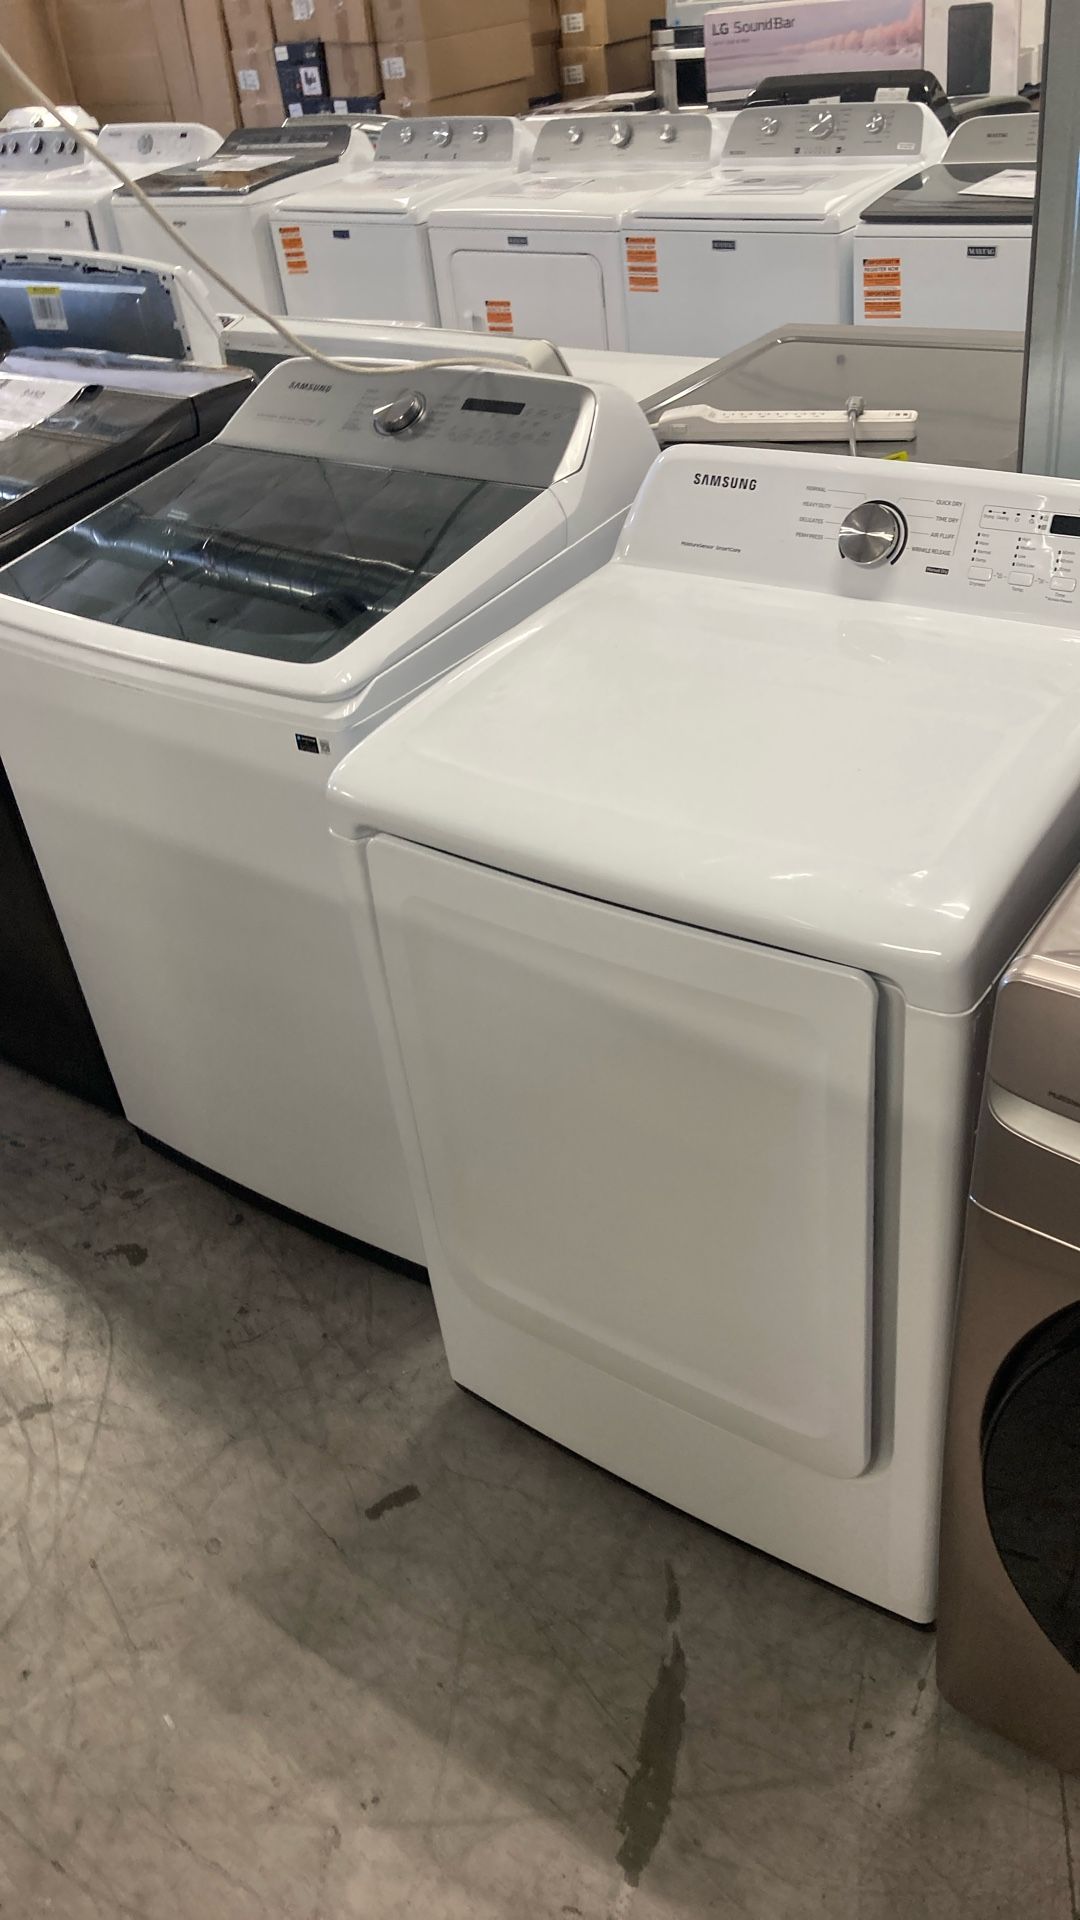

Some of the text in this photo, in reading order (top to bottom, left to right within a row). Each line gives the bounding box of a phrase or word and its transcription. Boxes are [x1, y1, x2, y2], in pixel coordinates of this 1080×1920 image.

[712, 17, 796, 36] LG SoundBar
[289, 381, 332, 393] SAMSUNG
[693, 473, 757, 490] SAMSUNG
